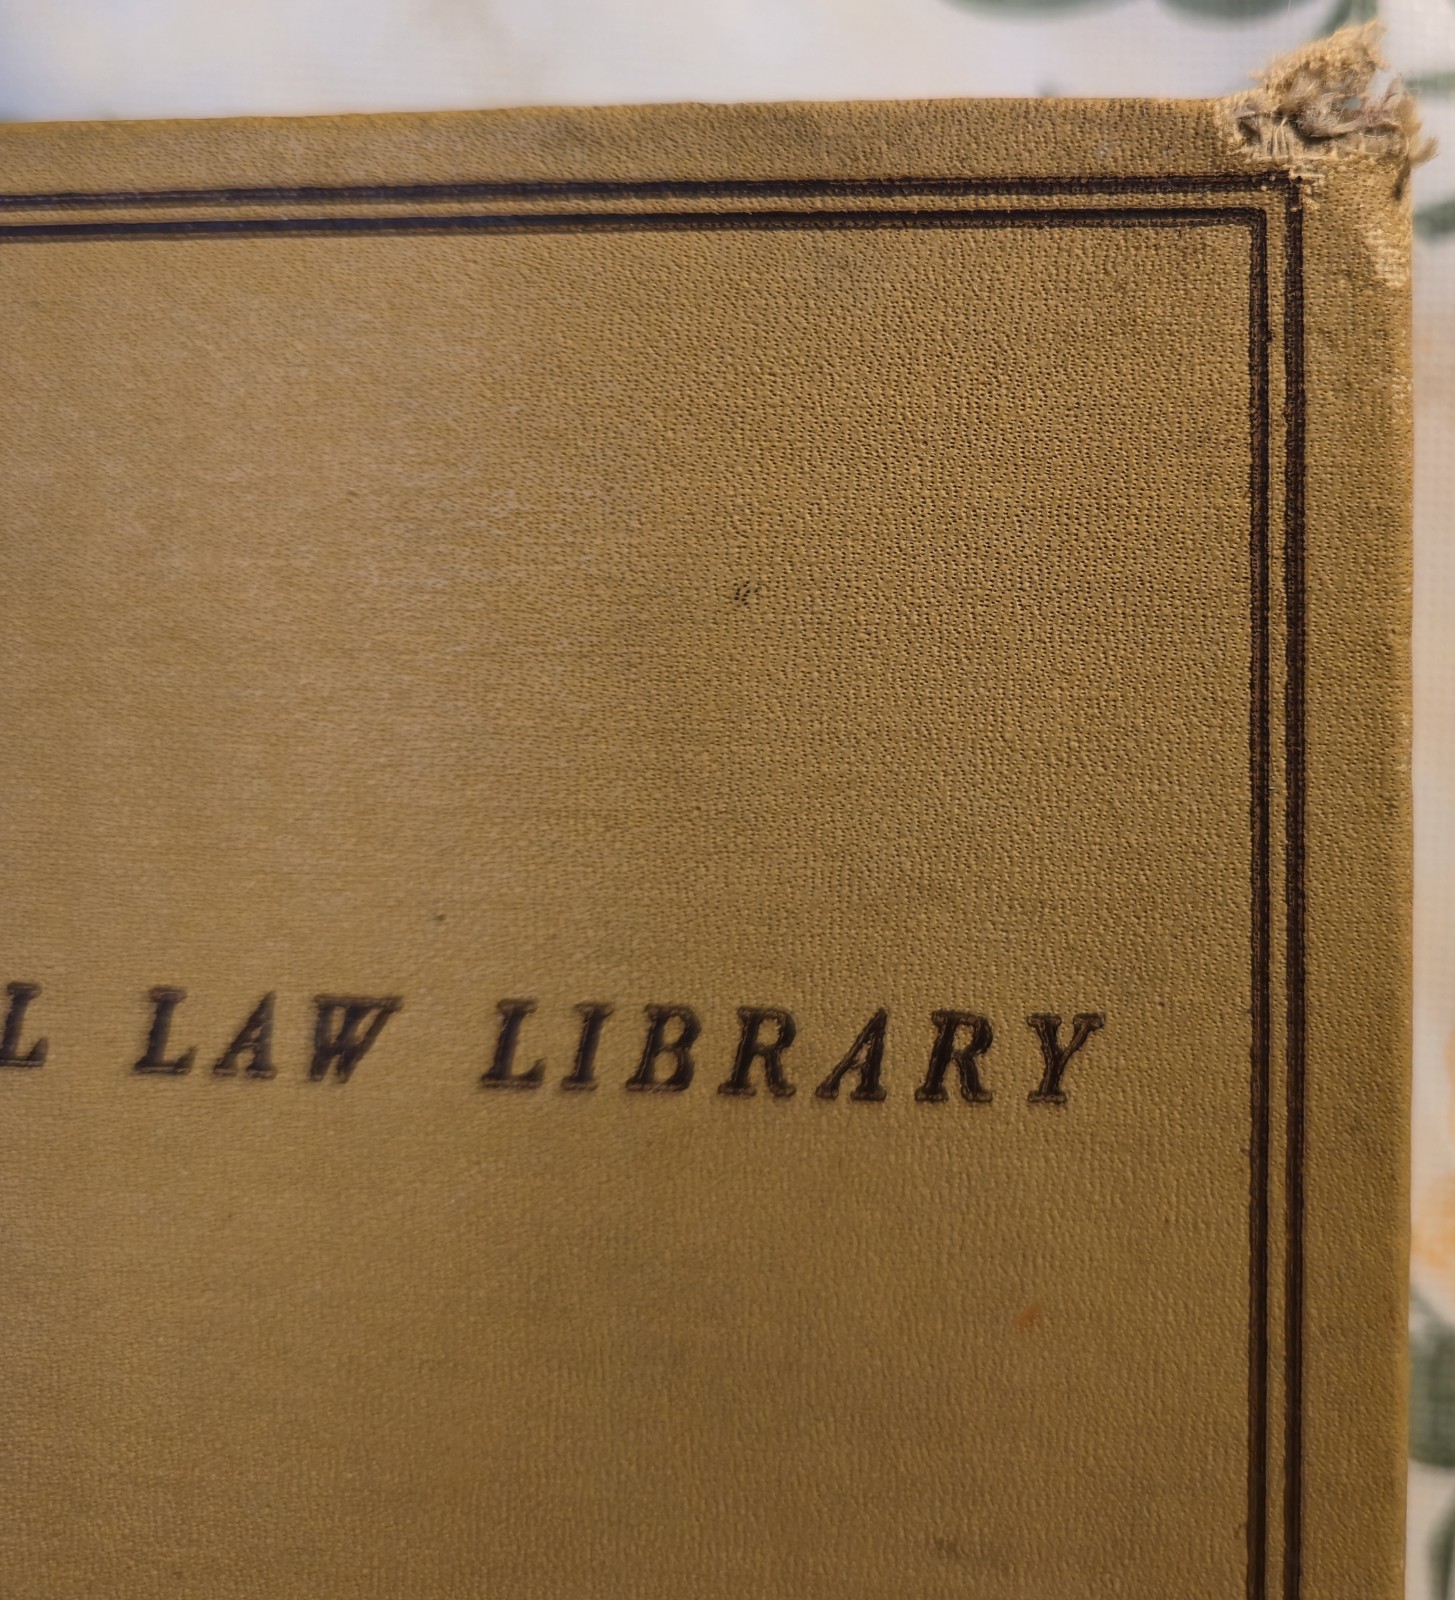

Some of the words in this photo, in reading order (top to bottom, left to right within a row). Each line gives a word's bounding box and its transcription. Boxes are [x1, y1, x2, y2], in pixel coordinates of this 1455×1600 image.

[0, 981, 49, 1068] L
[132, 986, 402, 1083] LAW
[479, 1000, 1106, 1105] LIBRARY
